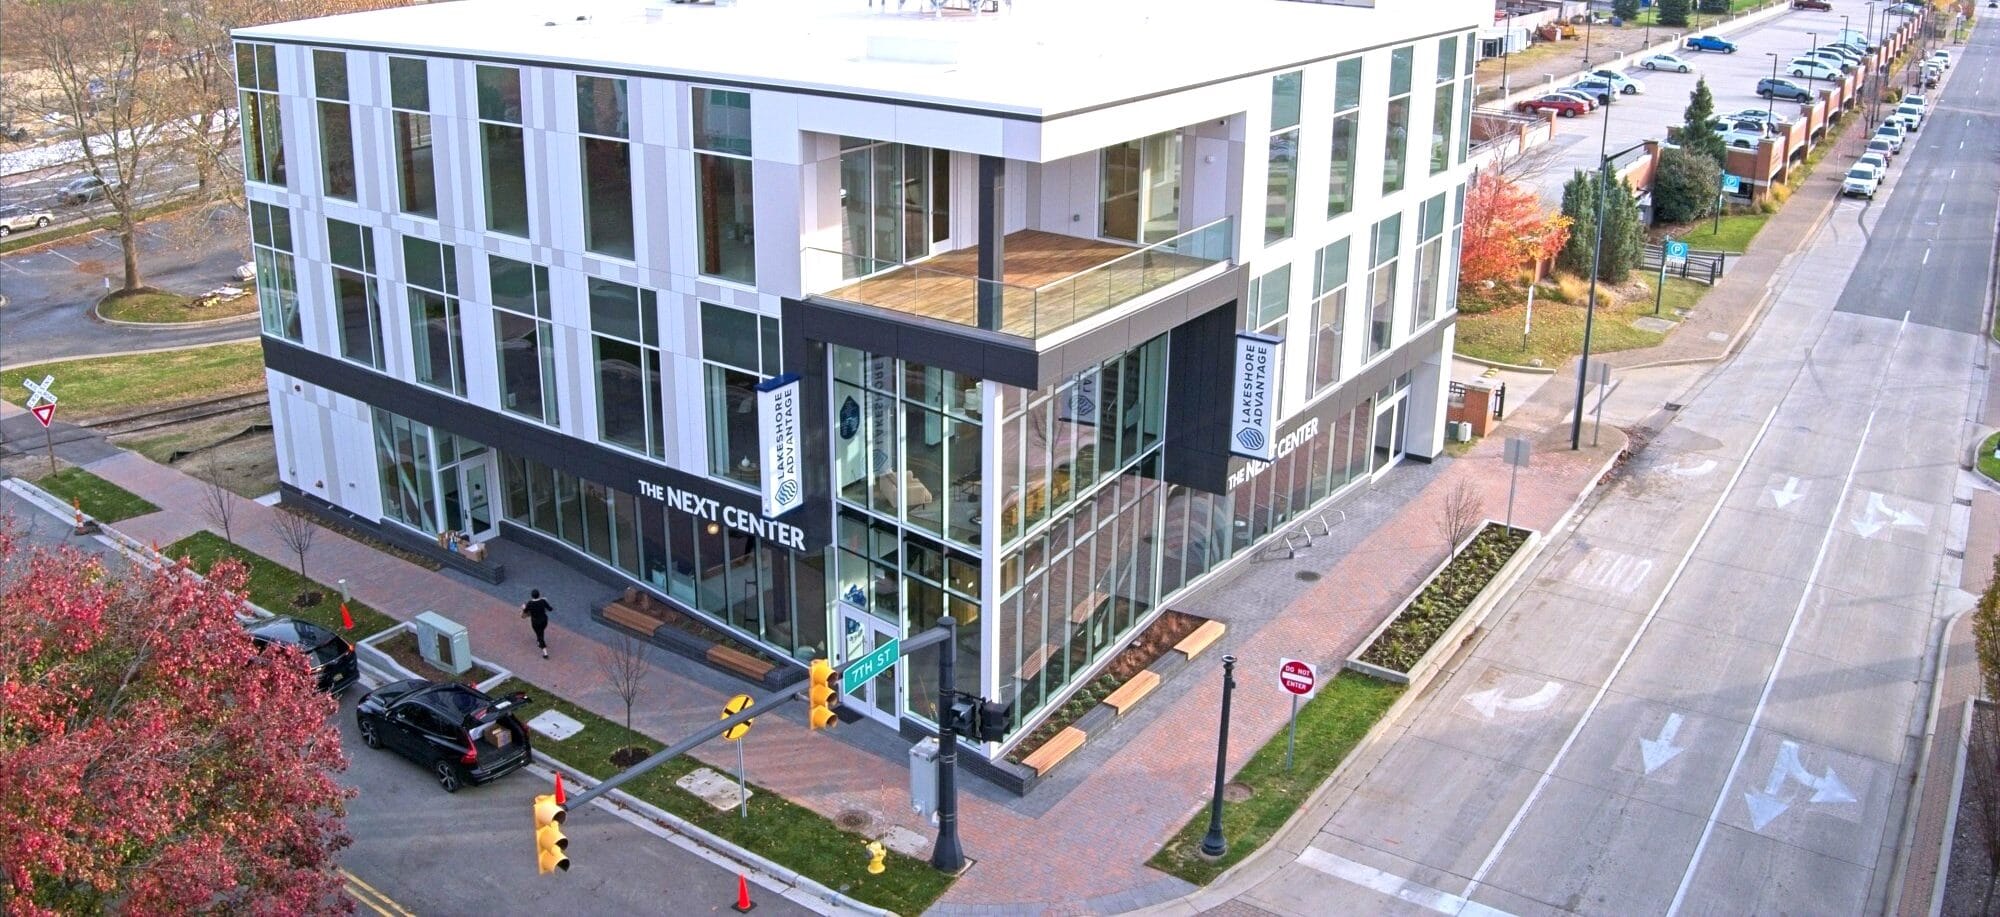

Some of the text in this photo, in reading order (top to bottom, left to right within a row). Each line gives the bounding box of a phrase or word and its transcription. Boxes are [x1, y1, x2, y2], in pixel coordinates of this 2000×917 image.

[1242, 344, 1255, 424] LAKESHORE
[1253, 347, 1267, 427] ADVANTAGE
[775, 392, 784, 480] LAKESHORE
[784, 388, 794, 474] ADVANTAGE
[1228, 467, 1245, 490] THE
[1278, 417, 1319, 459] CENTER
[638, 479, 806, 551] THE NEXT CENTER
[851, 648, 891, 683] 7TH ST
[1285, 665, 1310, 677] DO NOT
[1286, 680, 1307, 691] ENTER
